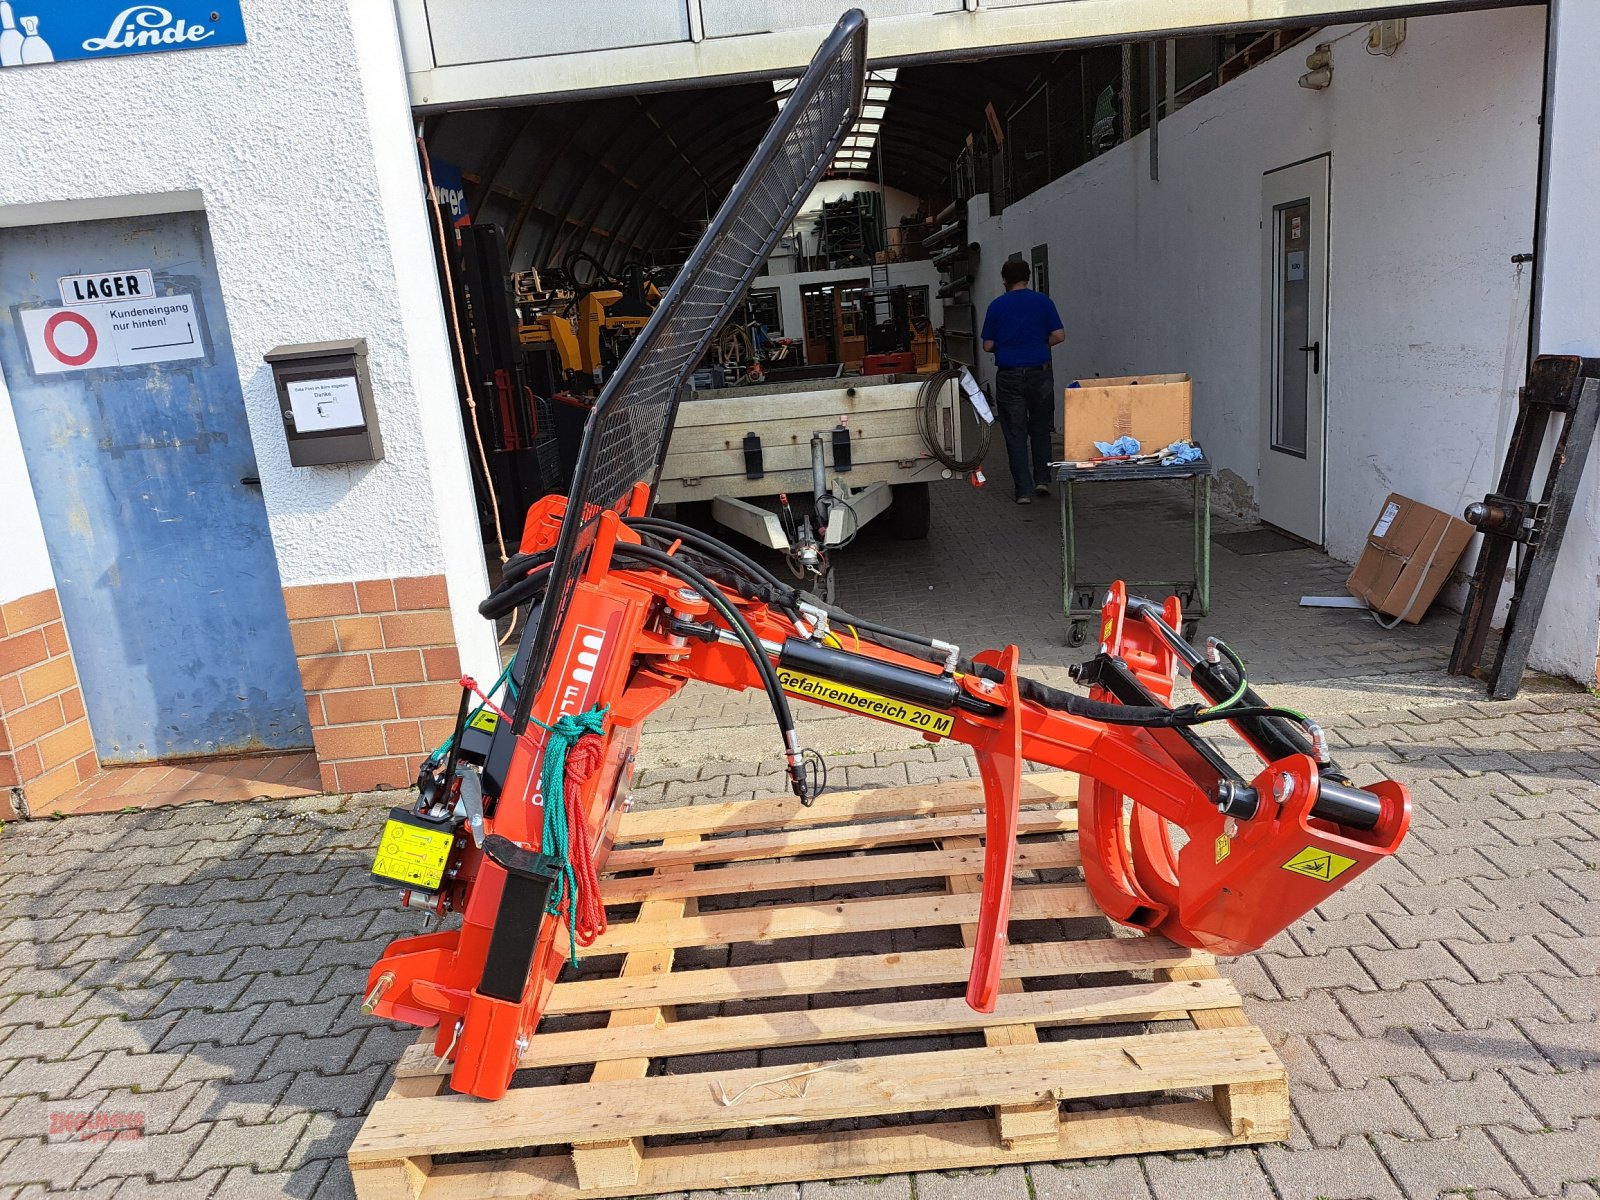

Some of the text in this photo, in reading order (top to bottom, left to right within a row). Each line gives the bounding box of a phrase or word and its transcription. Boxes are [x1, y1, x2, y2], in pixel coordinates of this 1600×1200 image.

[82, 5, 215, 52] Linde
[73, 275, 142, 301] LAGER
[109, 304, 189, 319] Kundeneingang
[113, 317, 167, 331] nur hinten!
[778, 672, 950, 732] Gefahrenbereich 20 M
